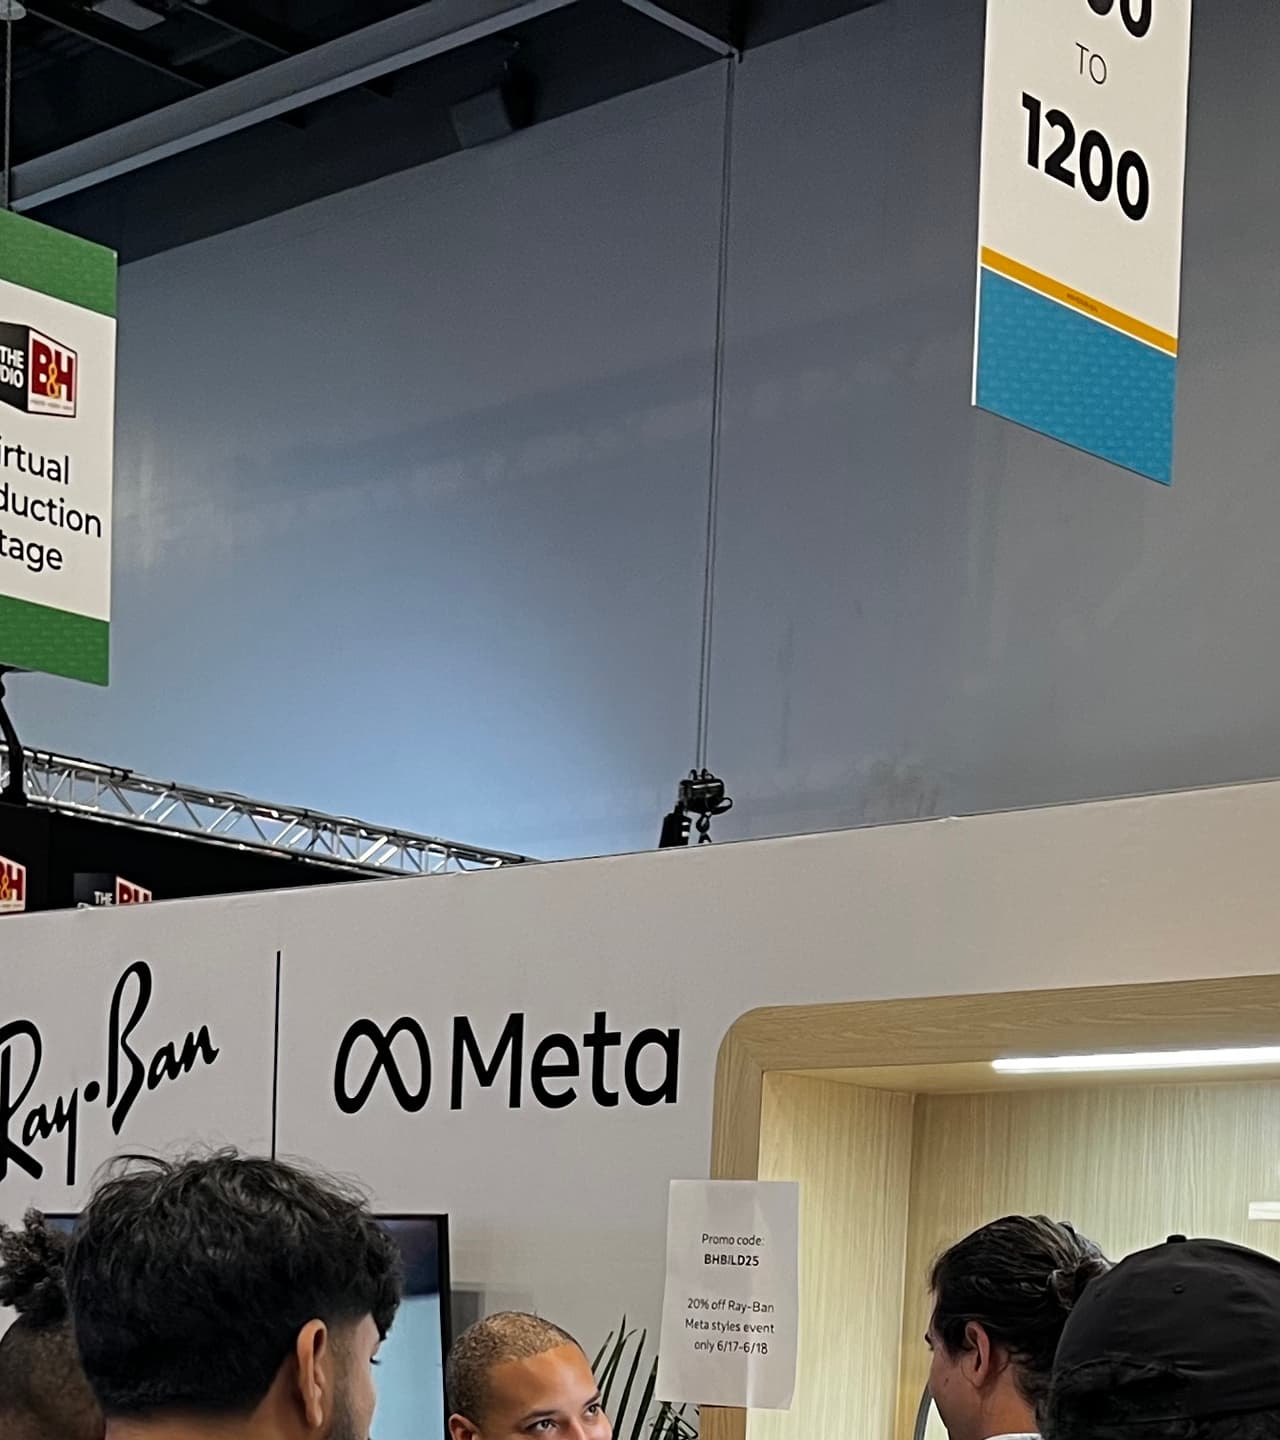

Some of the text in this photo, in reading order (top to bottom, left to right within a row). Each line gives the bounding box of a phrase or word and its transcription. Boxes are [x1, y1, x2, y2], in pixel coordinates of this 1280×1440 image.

[1075, 42, 1107, 84] TO
[1022, 91, 1149, 221] 1200
[31, 338, 74, 402] B&H
[94, 890, 113, 906] THE
[449, 1011, 681, 1110] Meta
[701, 1233, 735, 1245] Promo
[704, 1253, 760, 1266] BHBILD25
[687, 1298, 775, 1314] 20% off Ray-Ban
[685, 1318, 775, 1334] Meta styles event
[694, 1339, 768, 1355] only 6/17-6/18
